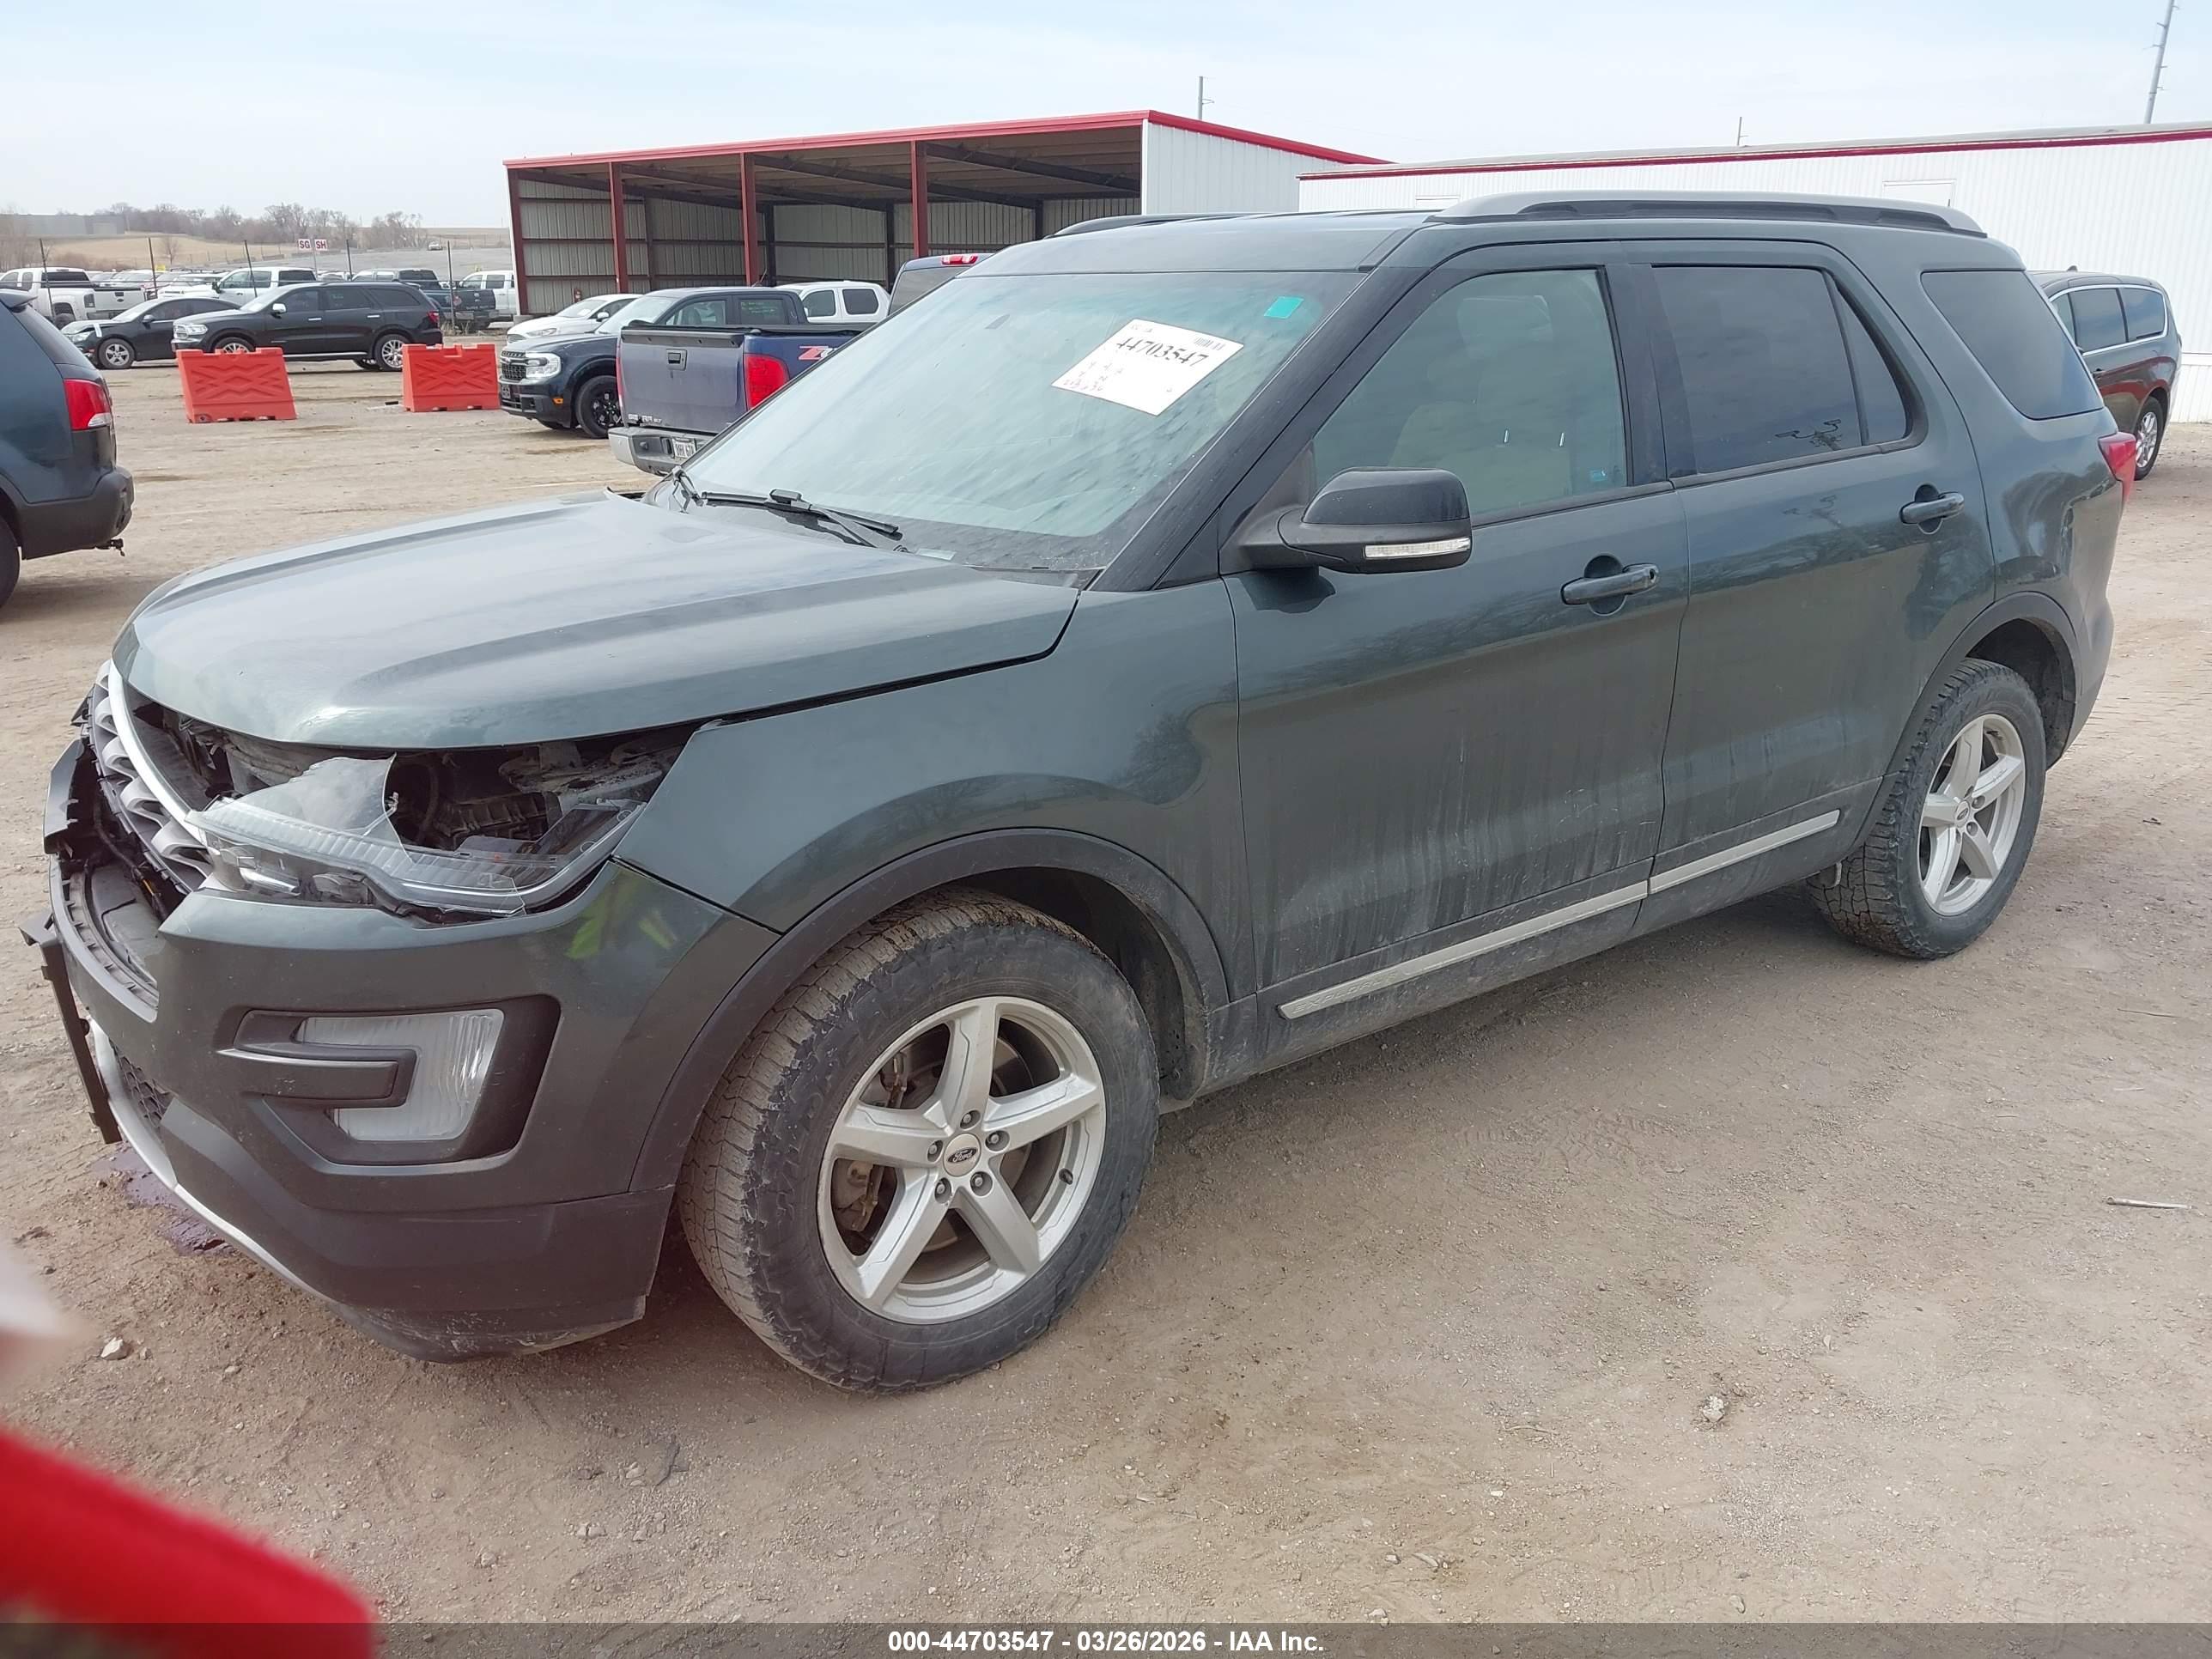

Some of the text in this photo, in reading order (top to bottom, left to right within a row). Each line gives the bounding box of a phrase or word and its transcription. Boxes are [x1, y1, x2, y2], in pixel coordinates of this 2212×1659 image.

[299, 240, 311, 249] SG
[315, 240, 327, 249] SH
[1116, 337, 1210, 368] 44703547
[951, 1148, 975, 1163] Ford
